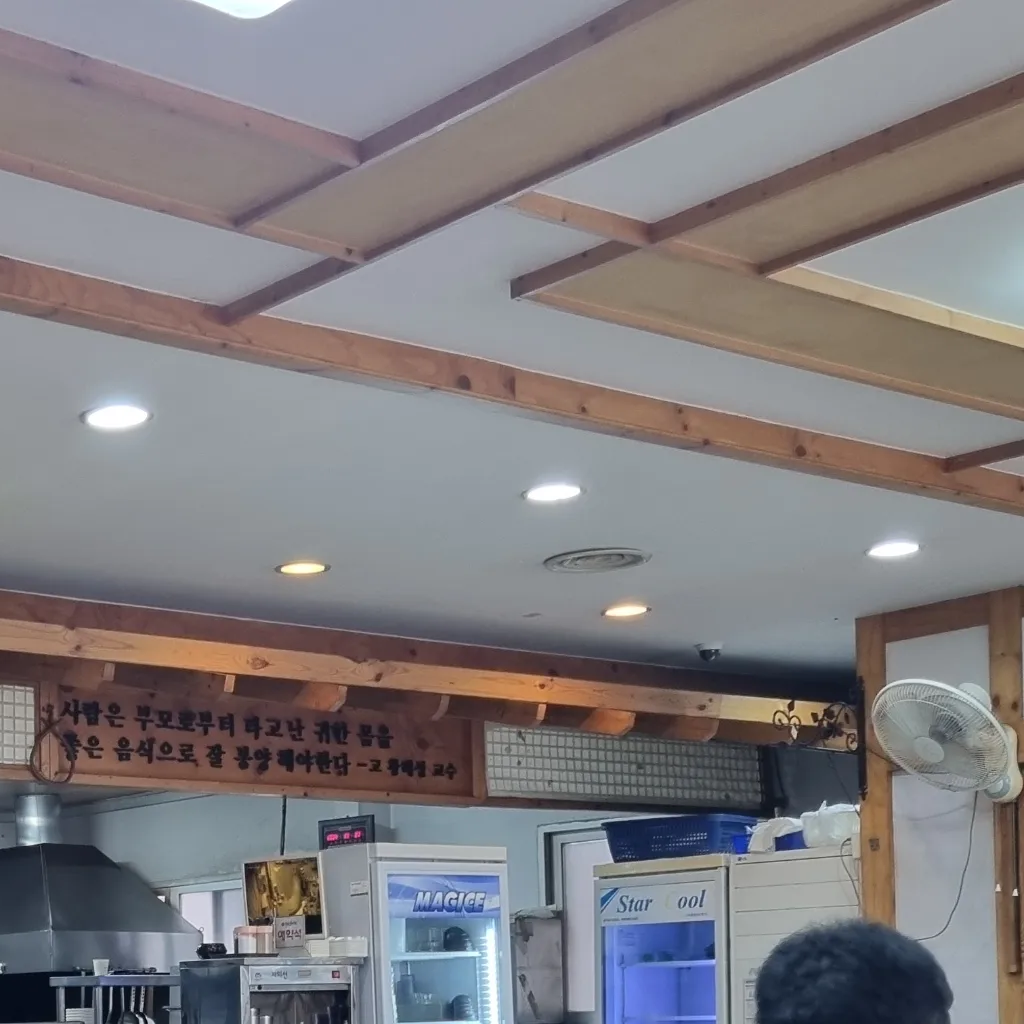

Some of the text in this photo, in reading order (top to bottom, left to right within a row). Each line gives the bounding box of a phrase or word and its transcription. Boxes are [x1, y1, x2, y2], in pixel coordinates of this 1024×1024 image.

[60, 699, 395, 749] 사람은 부모로부터 타고난 귀한 몸을
[60, 731, 104, 761] 좋은
[113, 736, 199, 766] 음식으로
[205, 743, 227, 768] 잘
[233, 745, 272, 773] 봉양
[432, 762, 458, 780] 교수
[412, 891, 487, 914] MAGICE
[617, 895, 653, 913] Star
[277, 929, 302, 941] 예약석
